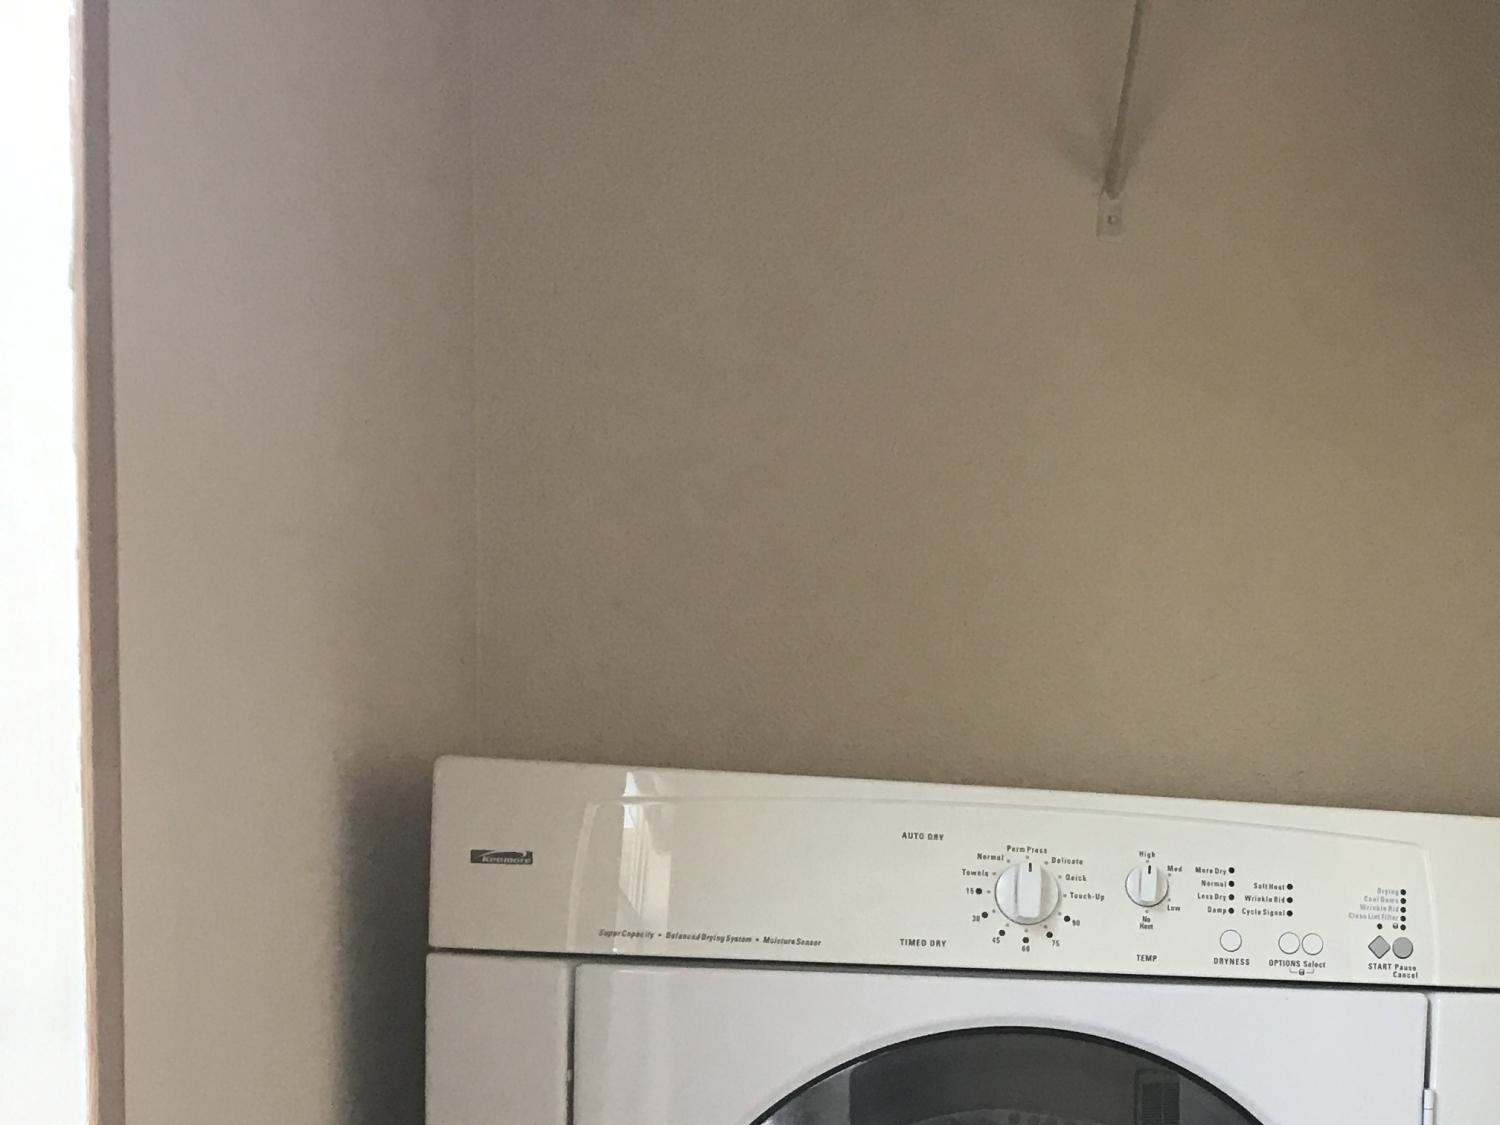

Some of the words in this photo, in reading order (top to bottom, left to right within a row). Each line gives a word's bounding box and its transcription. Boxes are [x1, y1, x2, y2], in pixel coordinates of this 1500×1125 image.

[901, 832, 925, 840] AUTO
[977, 853, 1004, 861] Normal
[1201, 880, 1227, 888] Normal
[966, 887, 974, 895] 15
[900, 938, 927, 947] TIMED
[930, 939, 947, 947] DRY
[1136, 953, 1158, 962] TEMP
[1213, 957, 1250, 966] DRYNESS
[1268, 959, 1301, 968] OPTIONS
[1367, 962, 1392, 971] START
